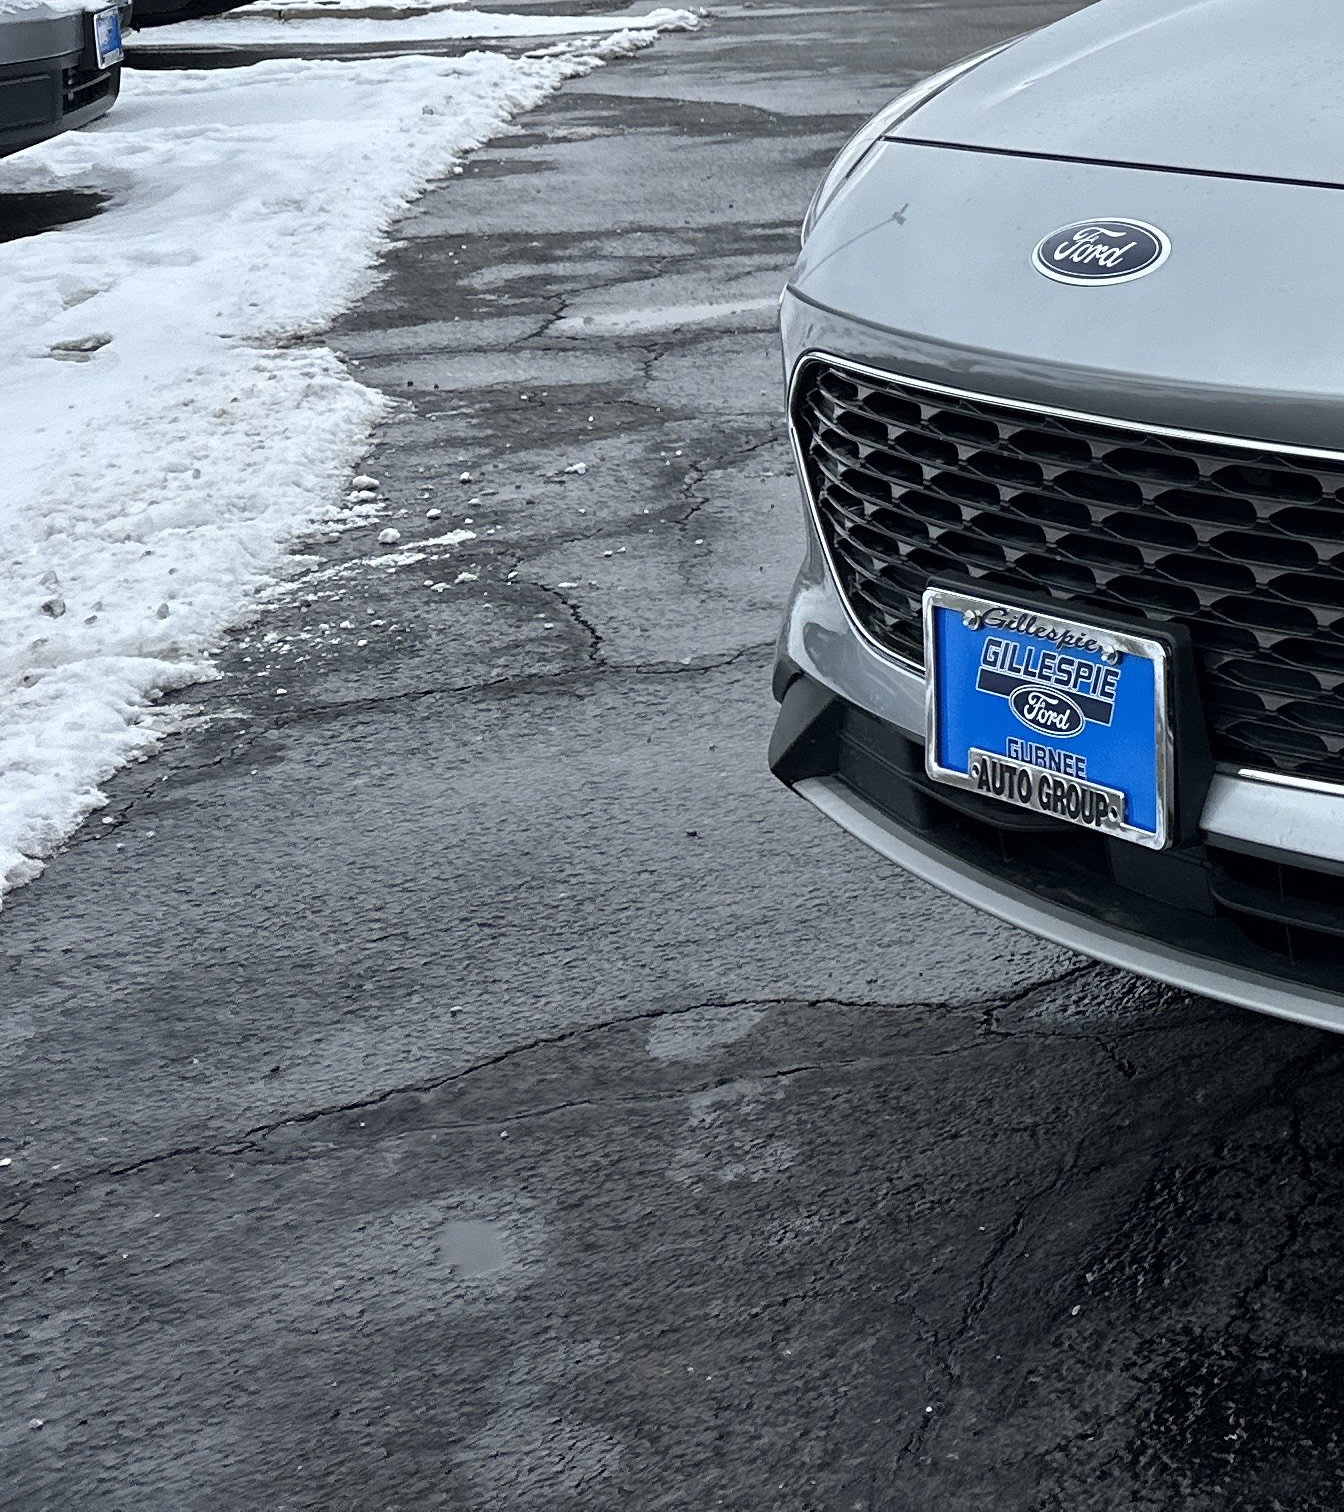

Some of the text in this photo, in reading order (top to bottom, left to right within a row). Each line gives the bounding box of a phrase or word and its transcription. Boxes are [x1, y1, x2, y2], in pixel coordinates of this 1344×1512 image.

[1053, 226, 1138, 267] Ford
[978, 607, 1103, 653] Gillespie
[980, 636, 1121, 700] GILLESPIE
[1023, 691, 1072, 730] Ford
[1006, 736, 1088, 779] GURNEE
[976, 757, 1109, 827] AUTO GROUP
